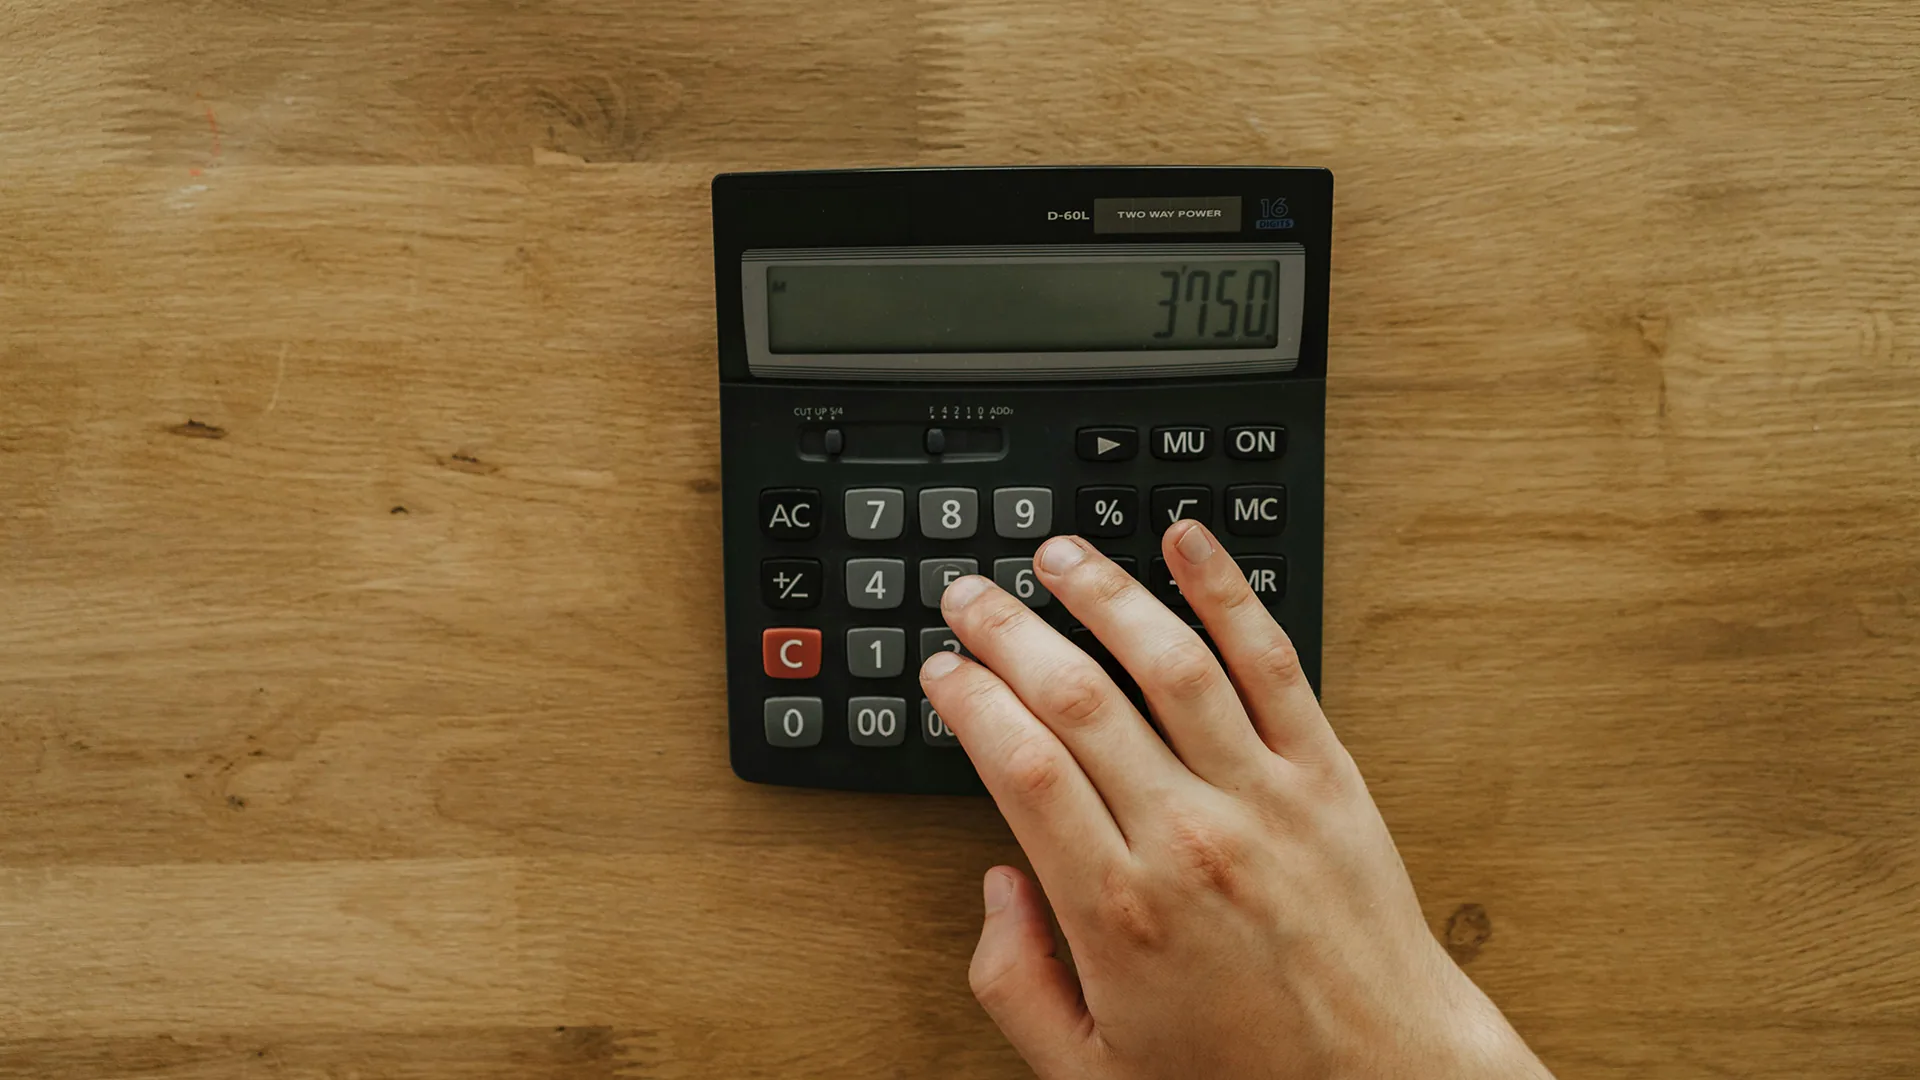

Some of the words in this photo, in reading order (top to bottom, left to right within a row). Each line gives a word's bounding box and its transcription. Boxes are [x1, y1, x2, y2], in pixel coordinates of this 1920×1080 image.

[1047, 210, 1090, 221] D-60L
[1117, 210, 1146, 219] TWO
[1149, 210, 1176, 219] WAY
[1178, 209, 1222, 218] POWER
[1260, 198, 1289, 218] 16
[1258, 219, 1292, 229] DIGITS
[793, 407, 812, 416] CUT
[815, 407, 827, 416] UP
[829, 406, 843, 416] 5/4
[929, 406, 935, 415] F
[941, 406, 948, 415] 4
[954, 406, 960, 415] 2
[966, 406, 971, 415] 1
[978, 406, 984, 415] 0
[1163, 431, 1205, 453] MU
[1235, 430, 1276, 453] ON
[769, 503, 811, 528] AC
[866, 500, 886, 529] 7
[941, 499, 962, 529] 8
[1015, 498, 1035, 528] 9
[1095, 499, 1123, 526] %
[1234, 497, 1278, 521] MC
[865, 570, 886, 599] 4
[1014, 568, 1035, 598] 6
[779, 639, 803, 669] C
[869, 640, 882, 669] 1
[783, 708, 804, 737] 0
[857, 708, 896, 737] 00
